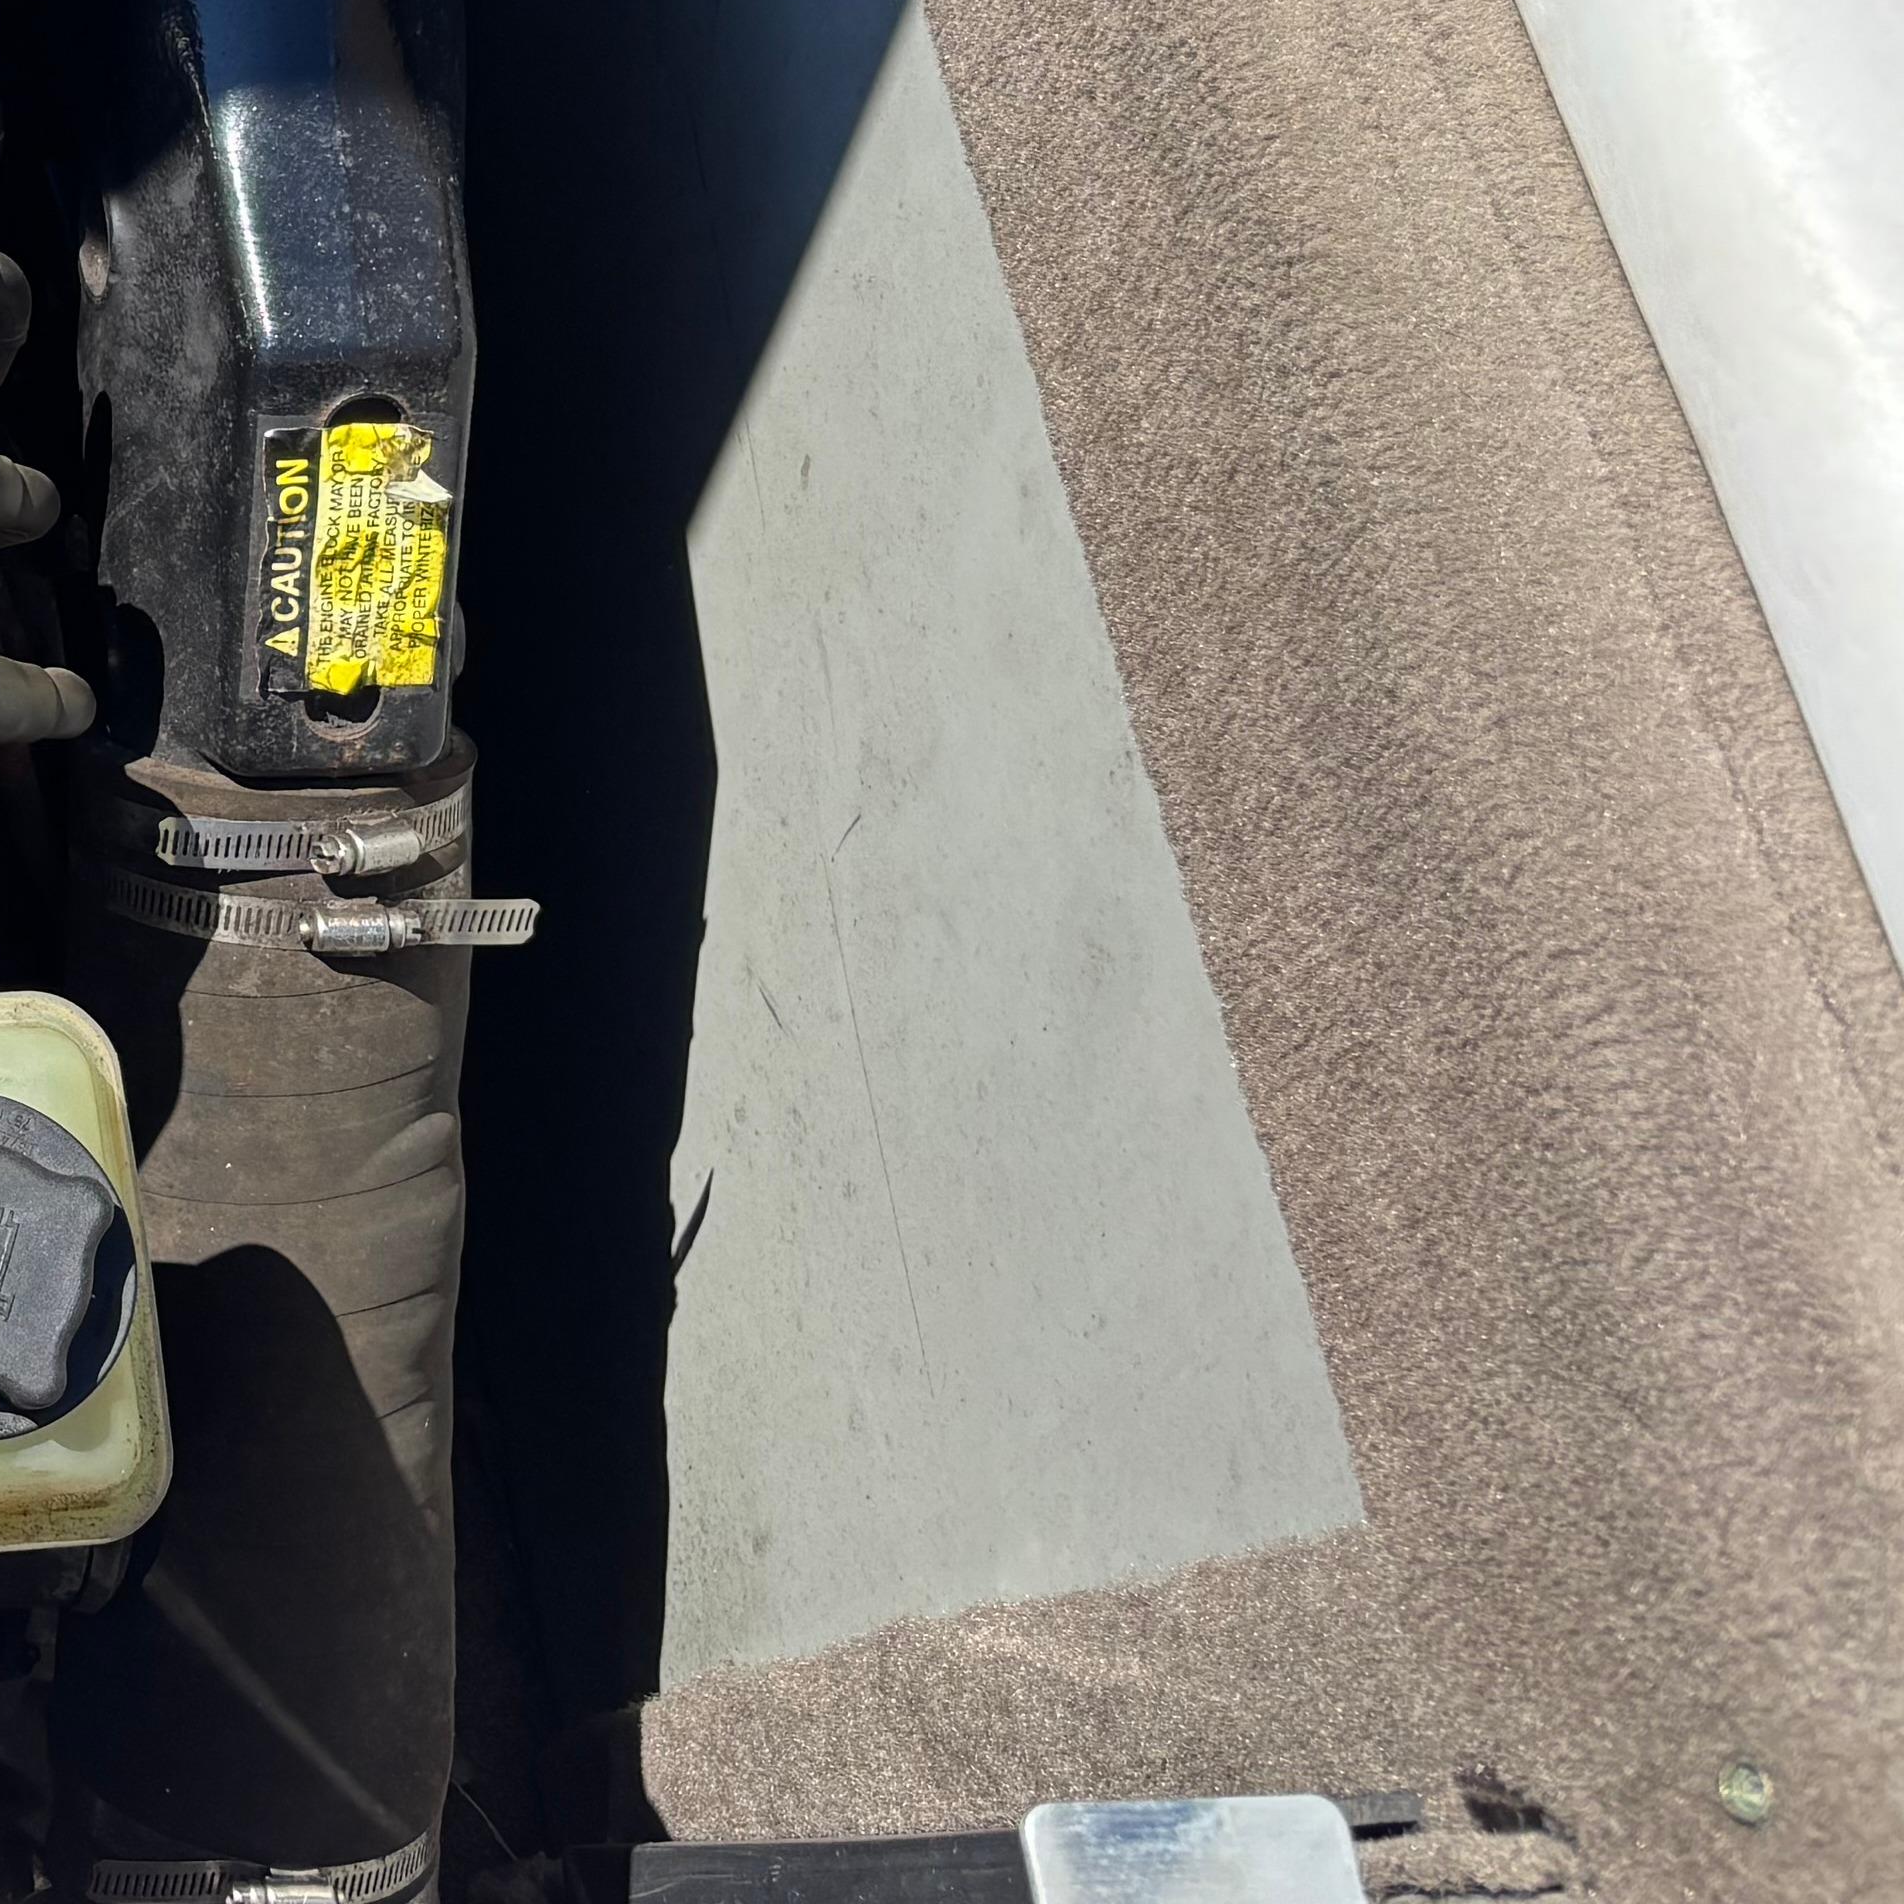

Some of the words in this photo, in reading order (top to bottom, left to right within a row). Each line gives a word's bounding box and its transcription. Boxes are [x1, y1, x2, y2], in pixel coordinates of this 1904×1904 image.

[331, 449, 345, 473] OR
[328, 478, 344, 511] MAY
[348, 478, 364, 518] BEEN
[270, 458, 310, 622] CAUTION
[321, 516, 341, 567] BLOCK
[339, 566, 355, 601] NOT
[378, 566, 395, 594] ALL
[390, 546, 413, 652] APPROPRIATE
[403, 518, 414, 540] TO
[319, 571, 334, 633] ENGINE
[373, 600, 390, 638] TAKE
[338, 607, 354, 640] MAY
